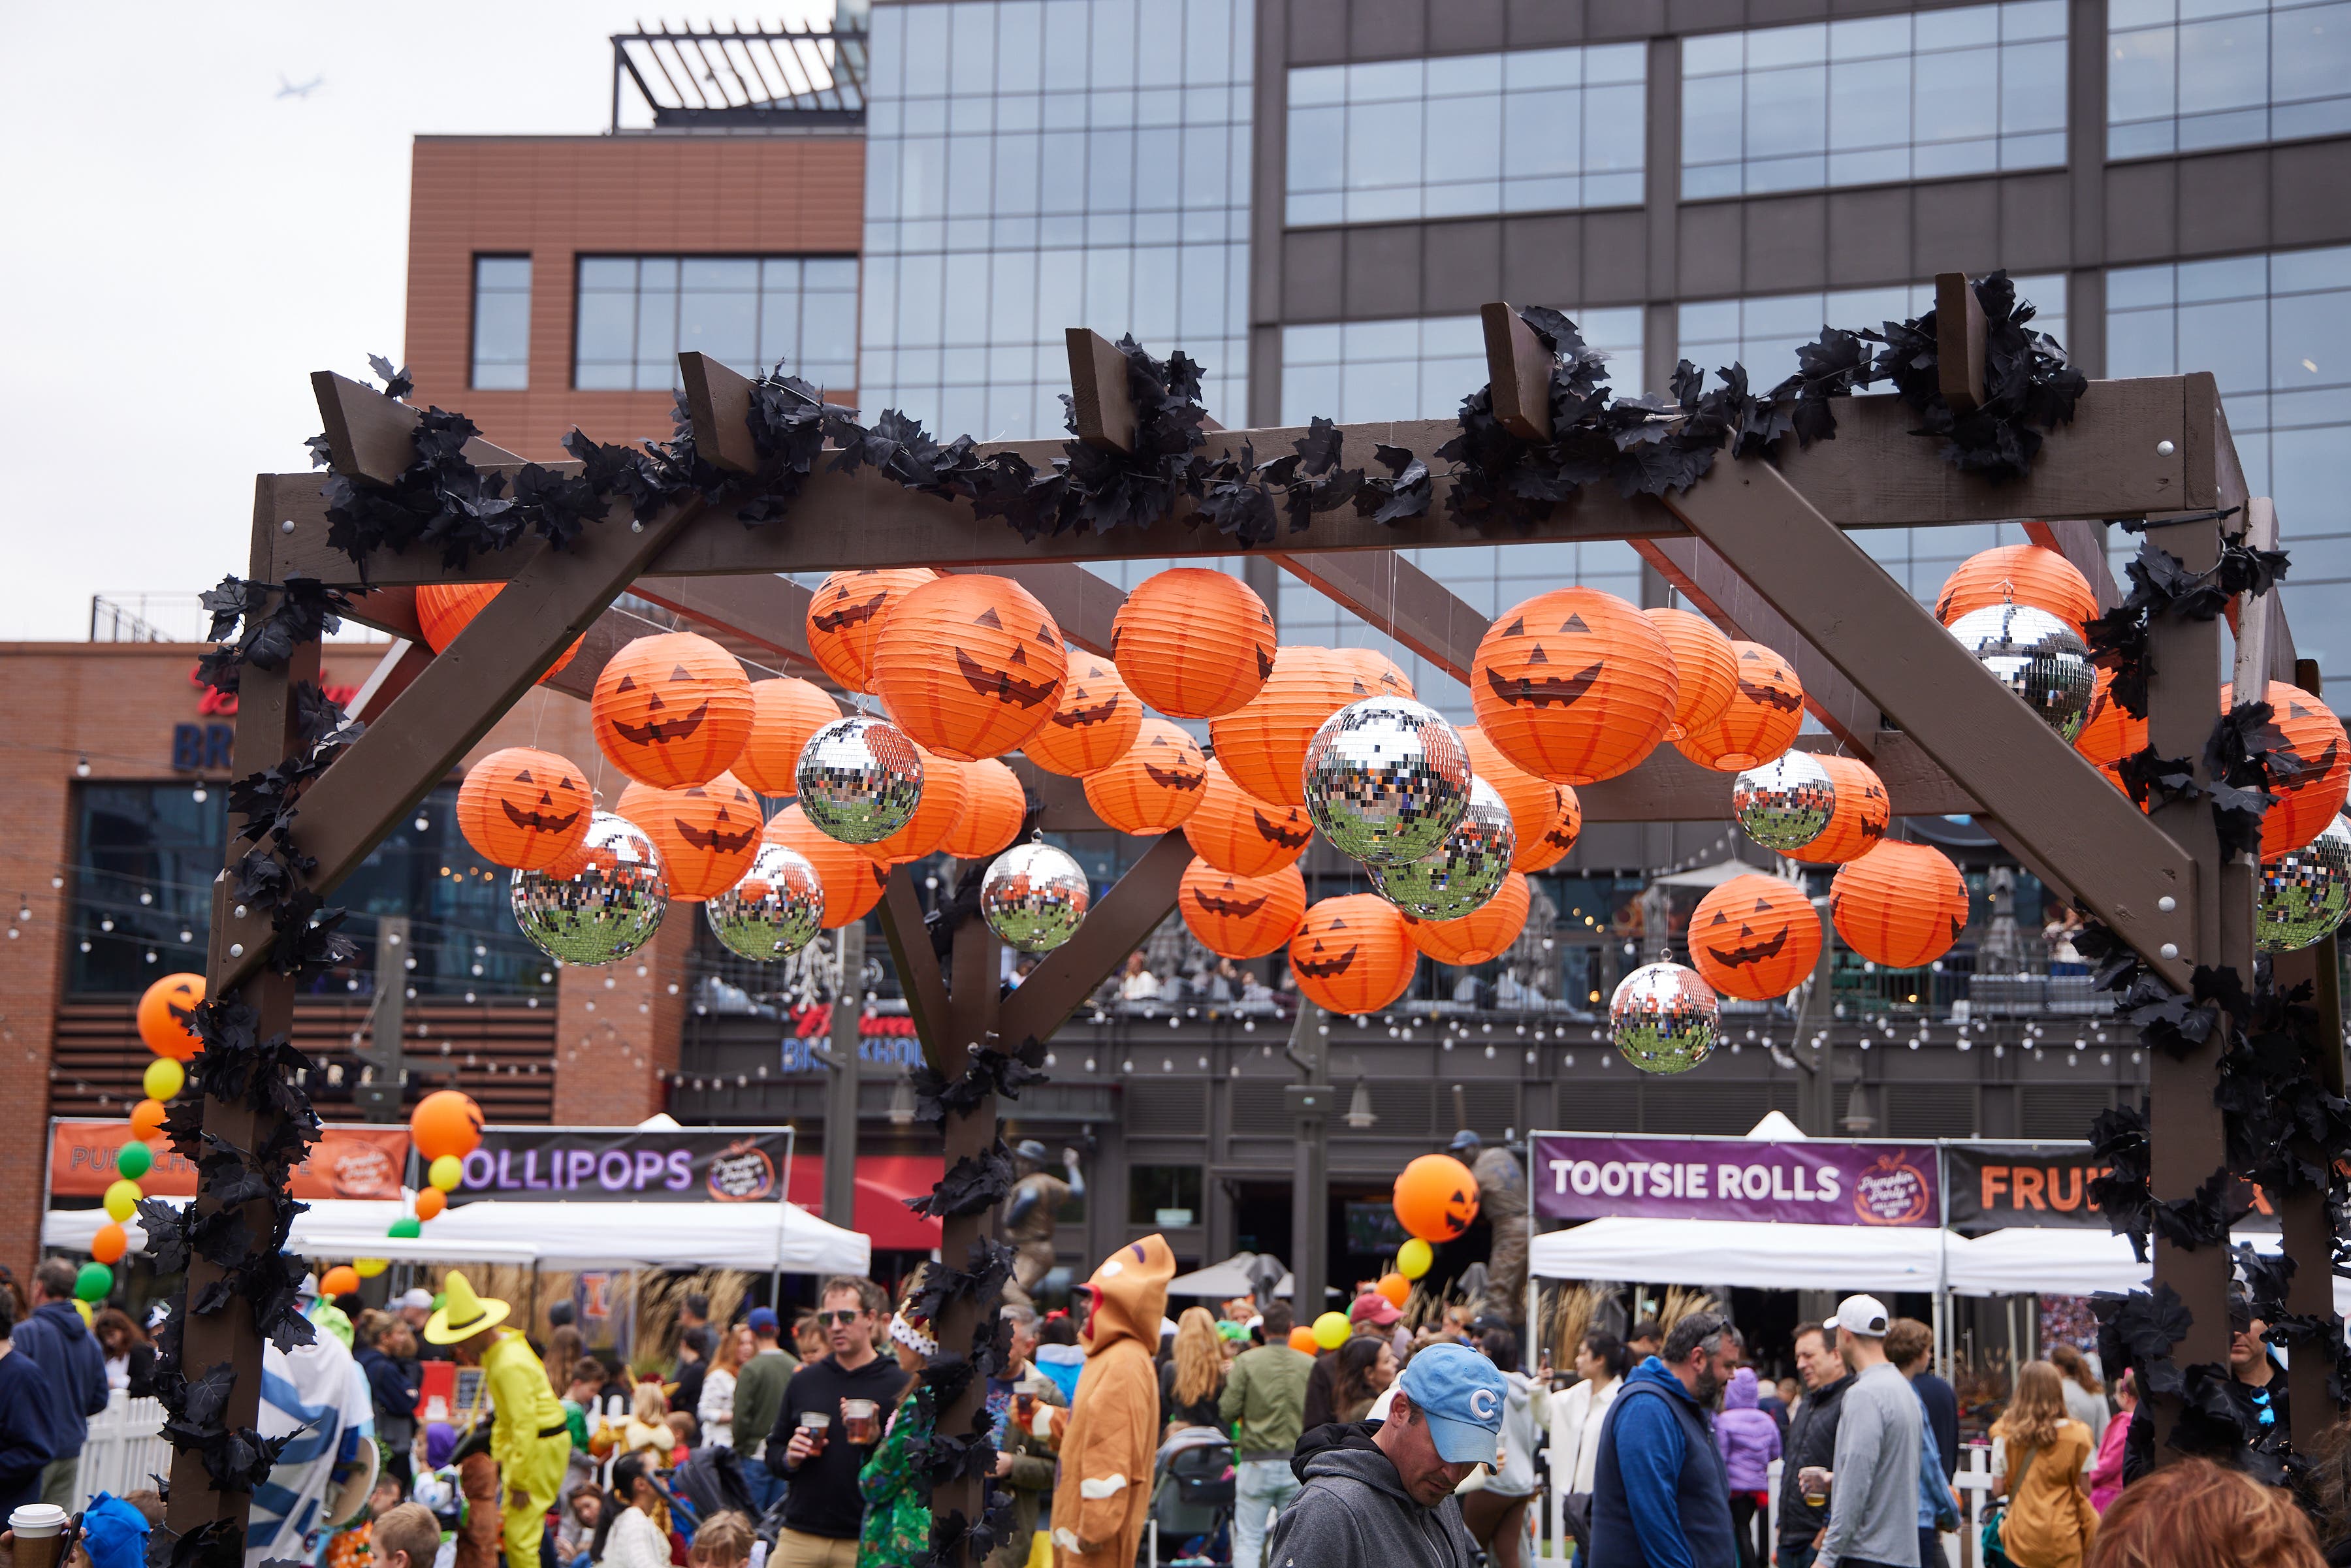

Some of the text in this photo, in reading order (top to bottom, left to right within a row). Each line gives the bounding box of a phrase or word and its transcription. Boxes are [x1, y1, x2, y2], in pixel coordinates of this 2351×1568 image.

[458, 1148, 694, 1192] OLLIPOPS
[1549, 1160, 1841, 1202] TOOTSIE ROLLS
[1470, 1388, 1497, 1420] C
